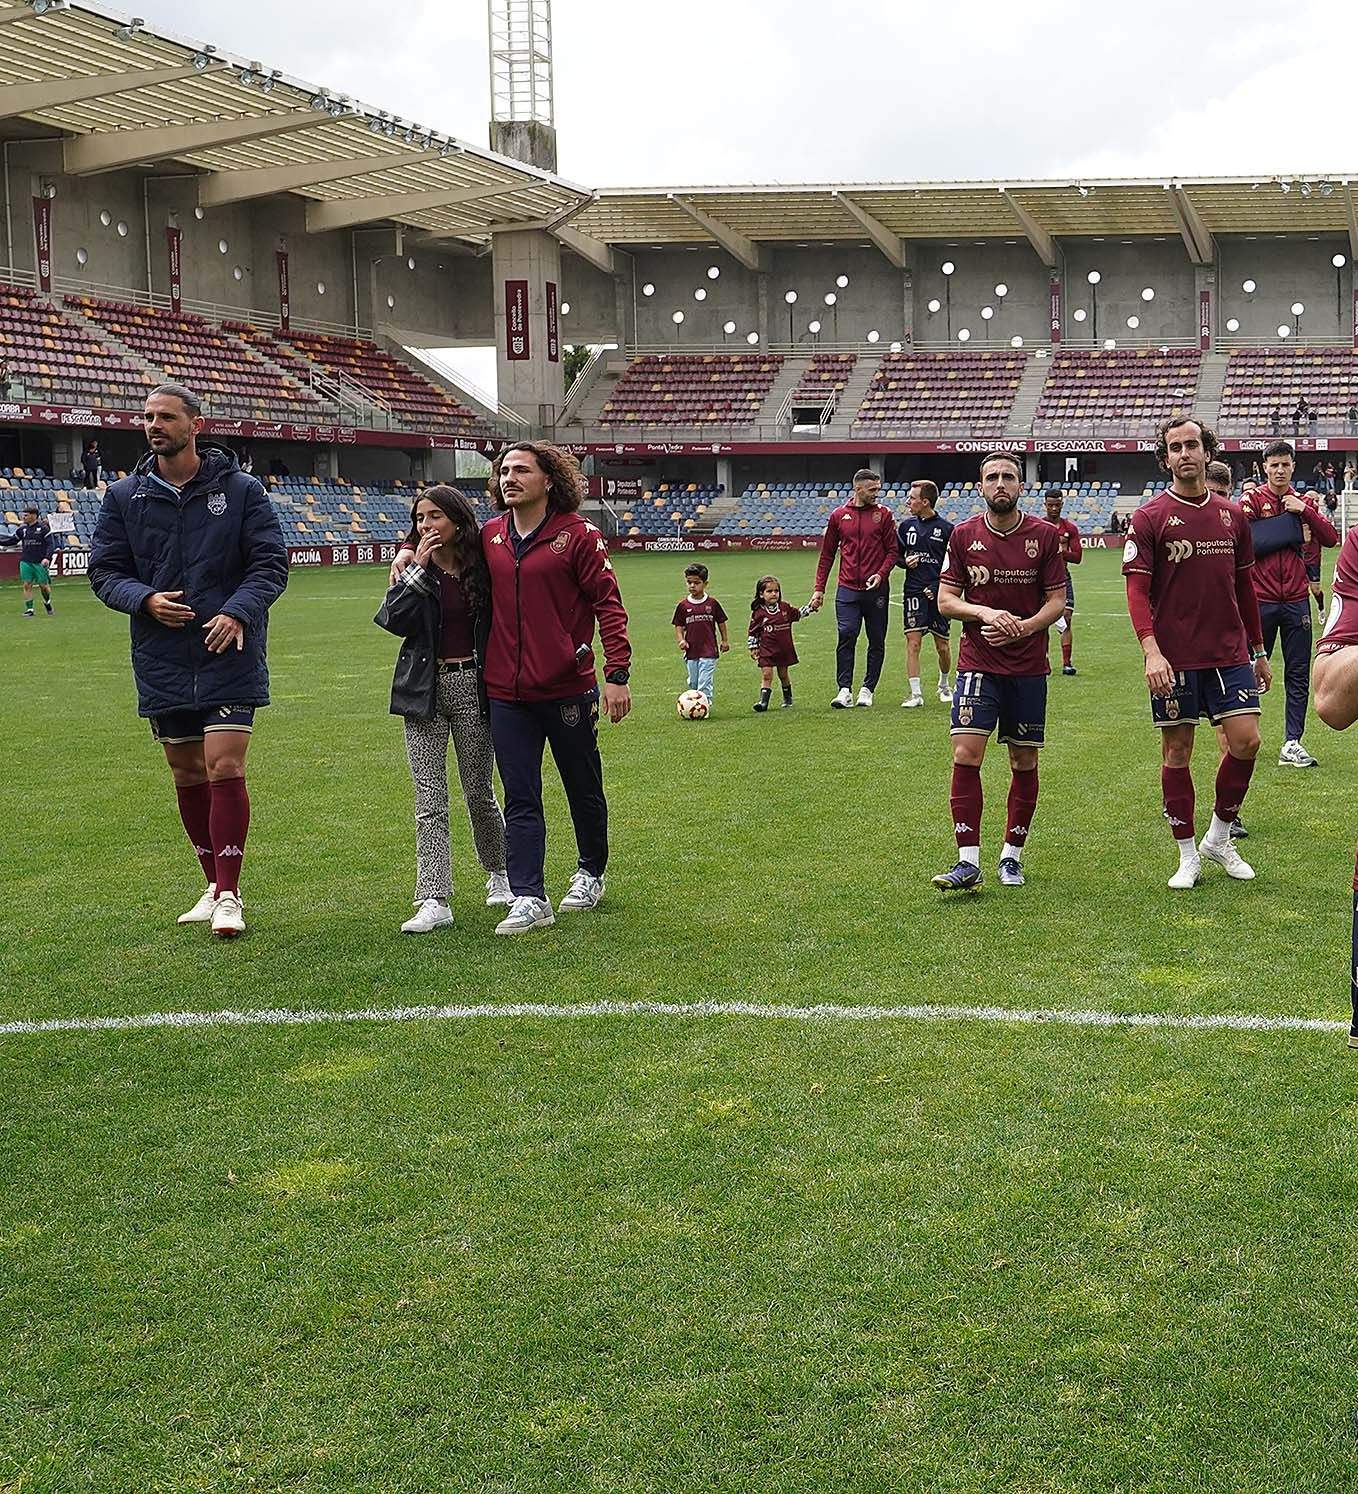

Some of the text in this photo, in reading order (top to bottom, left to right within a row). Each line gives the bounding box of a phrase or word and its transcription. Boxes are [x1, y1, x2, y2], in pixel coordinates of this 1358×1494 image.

[459, 439, 477, 449] Barca
[955, 440, 1106, 451] CONSERVAS PESCAMAR
[645, 541, 695, 550] PESCAMAR
[906, 532, 918, 546] 10
[291, 548, 321, 564] ACUÑA
[906, 597, 920, 612] 10
[963, 672, 984, 696] 11
